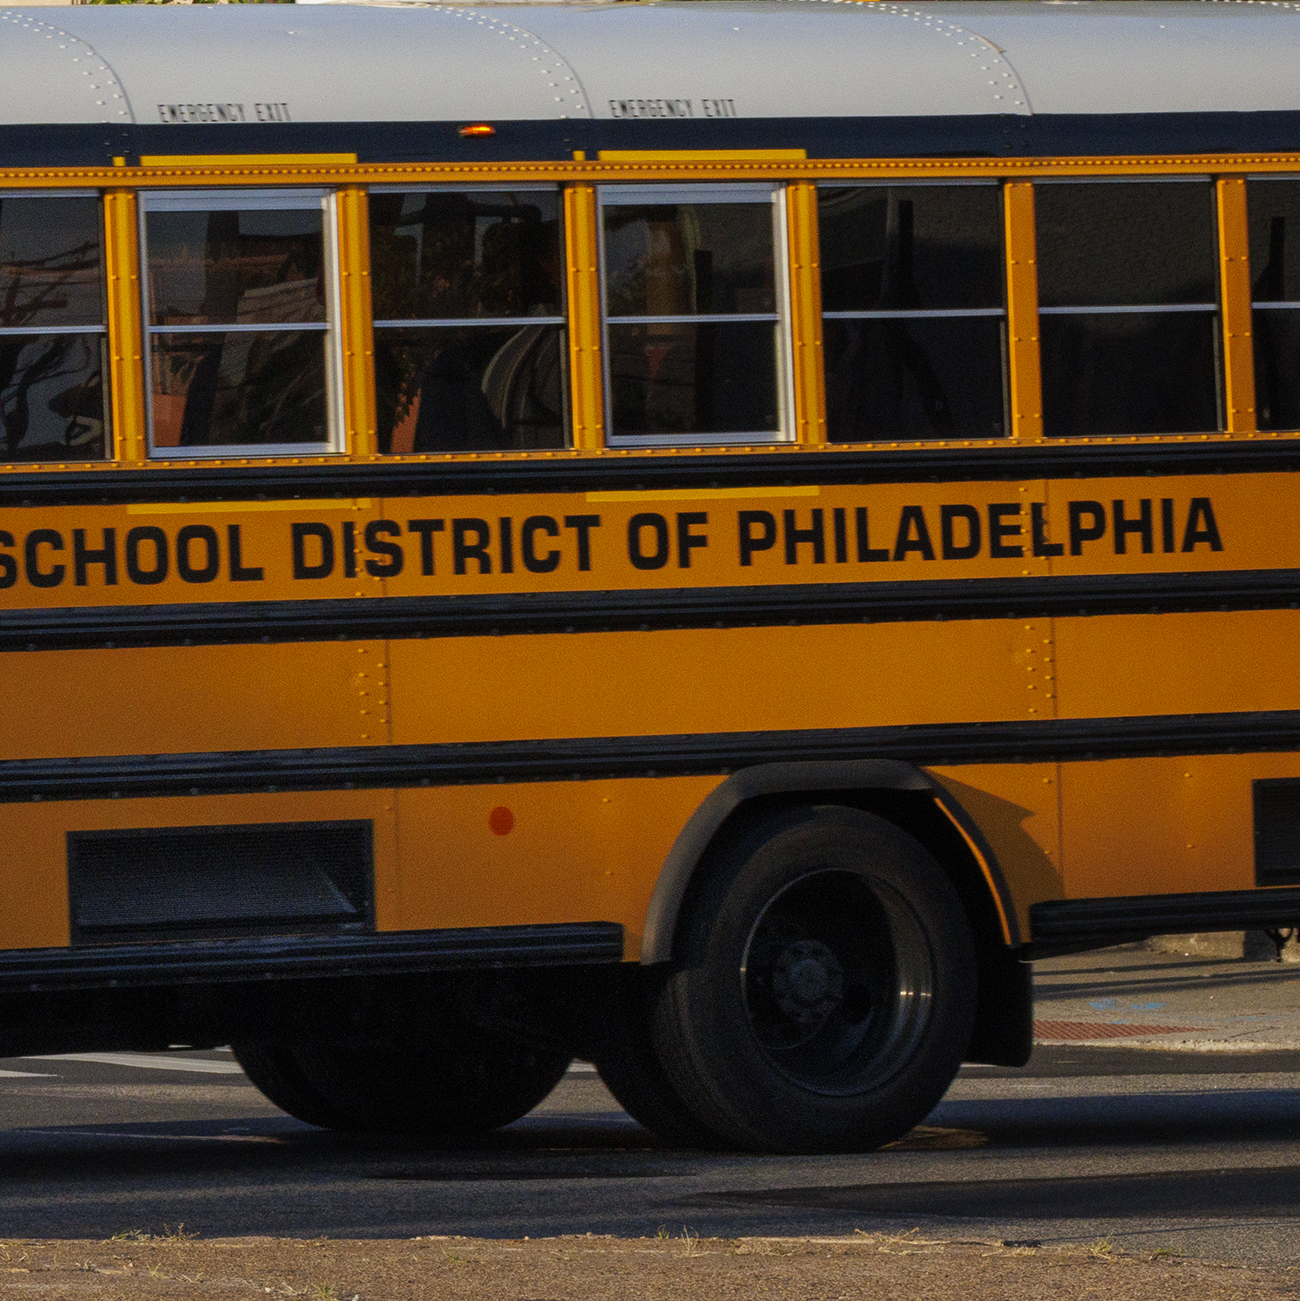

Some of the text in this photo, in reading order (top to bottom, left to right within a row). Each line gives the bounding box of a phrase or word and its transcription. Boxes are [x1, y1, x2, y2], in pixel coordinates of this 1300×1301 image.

[157, 102, 292, 123] EMERGENCY EXIT
[608, 98, 738, 118] EMERGENCY EXIT
[291, 515, 602, 580] DISTRICT
[627, 511, 708, 571] OF
[738, 497, 1225, 567] PHILADELPHIA
